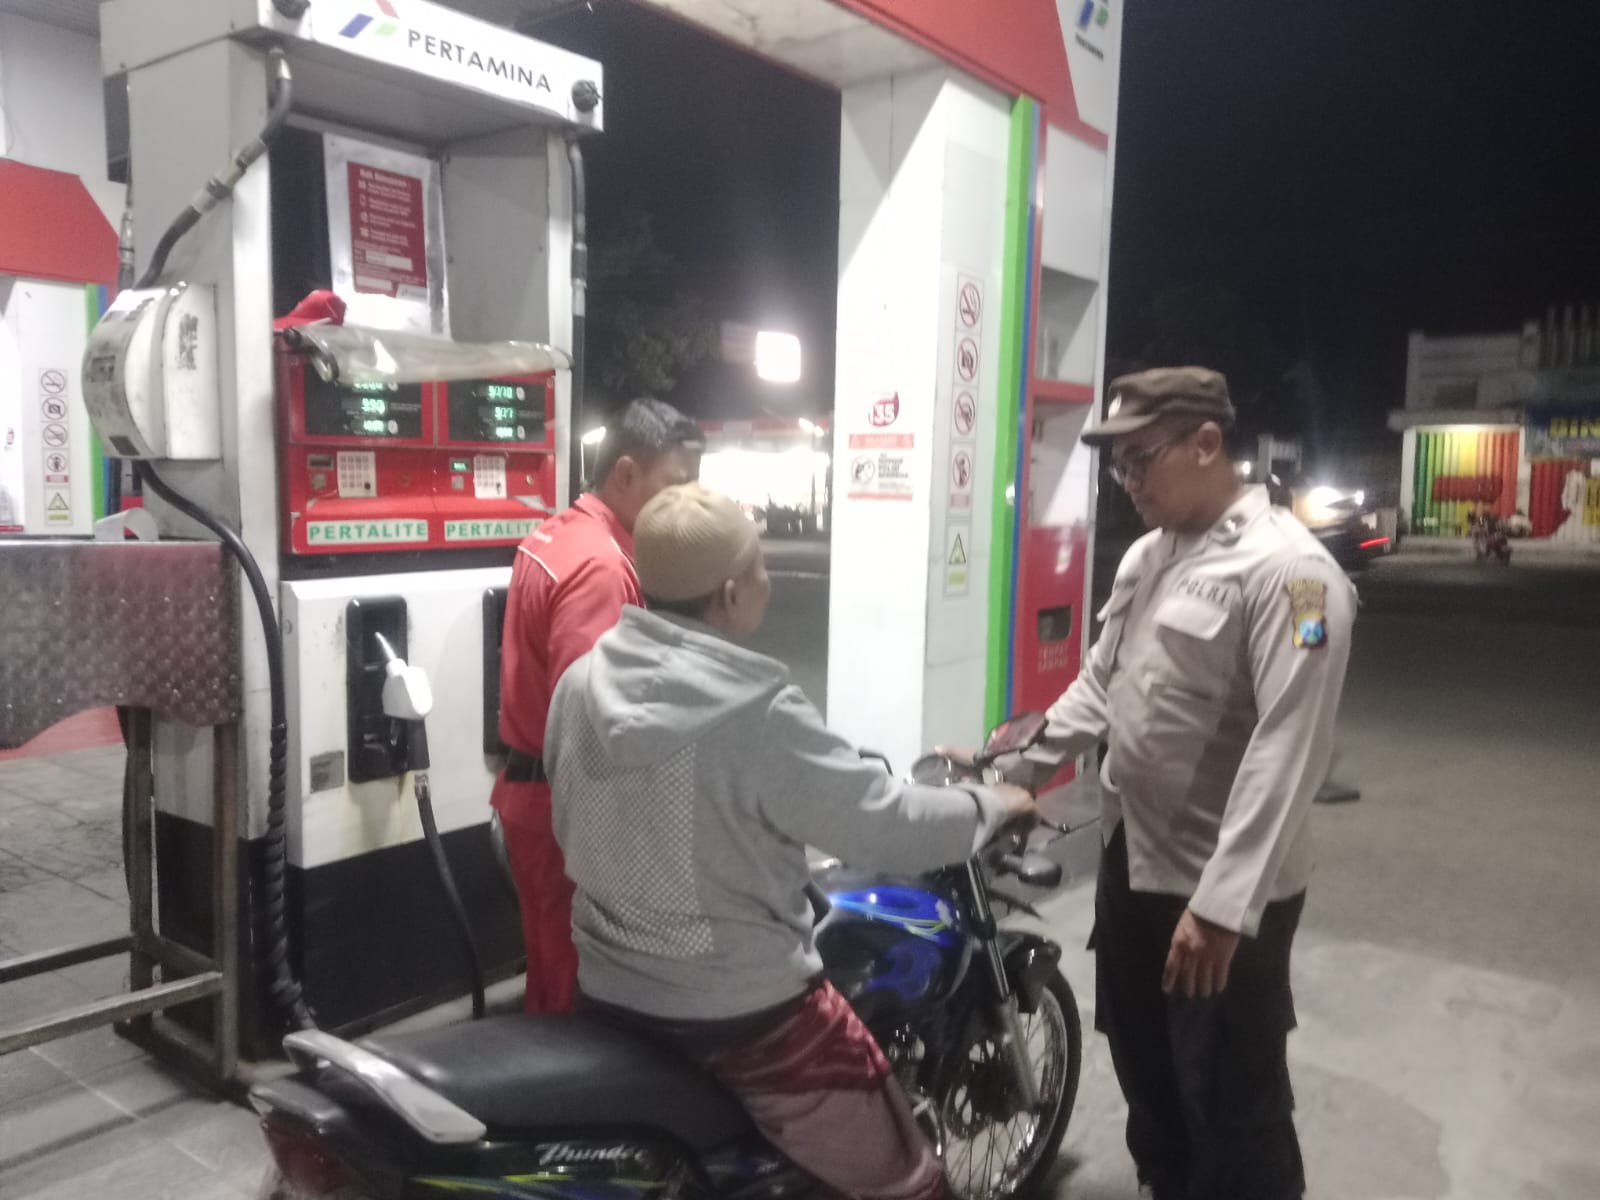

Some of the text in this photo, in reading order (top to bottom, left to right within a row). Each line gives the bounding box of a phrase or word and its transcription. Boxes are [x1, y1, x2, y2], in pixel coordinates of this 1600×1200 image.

[407, 28, 551, 93] PERTAMINA
[308, 521, 427, 540] PERTALITE
[1177, 577, 1230, 606] POLRI
